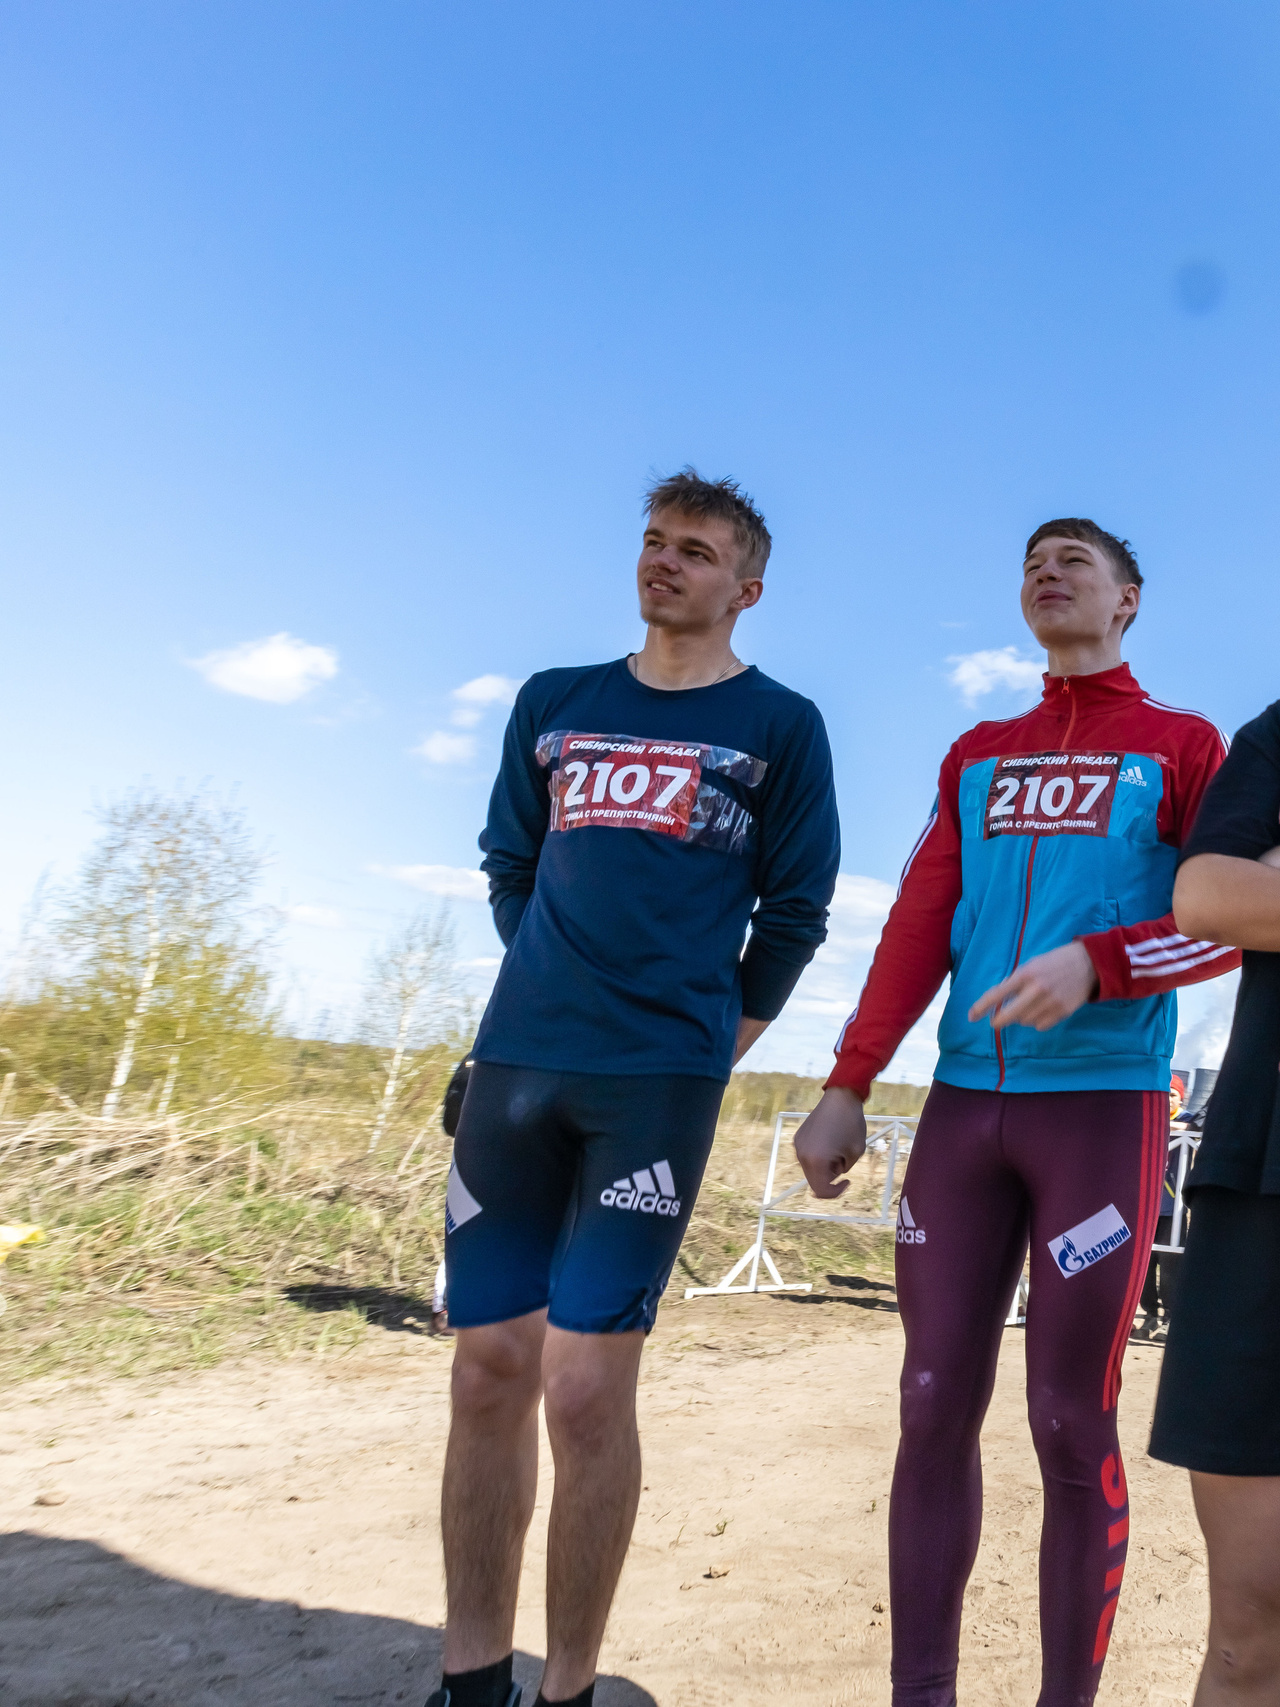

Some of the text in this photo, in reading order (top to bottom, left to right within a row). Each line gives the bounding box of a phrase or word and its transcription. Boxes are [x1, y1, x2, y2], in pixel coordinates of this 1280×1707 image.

[569, 740, 701, 758] СИБИРСКИЙ ПРЕДЕЛ
[1002, 754, 1119, 768] СИБИРСКИЙ ПРЕДЕЛ
[564, 760, 692, 809] 2107
[989, 775, 1111, 818] 2107
[1015, 821, 1022, 829] С
[600, 1187, 681, 1217] adidas
[1084, 1226, 1130, 1264] GAZPROM
